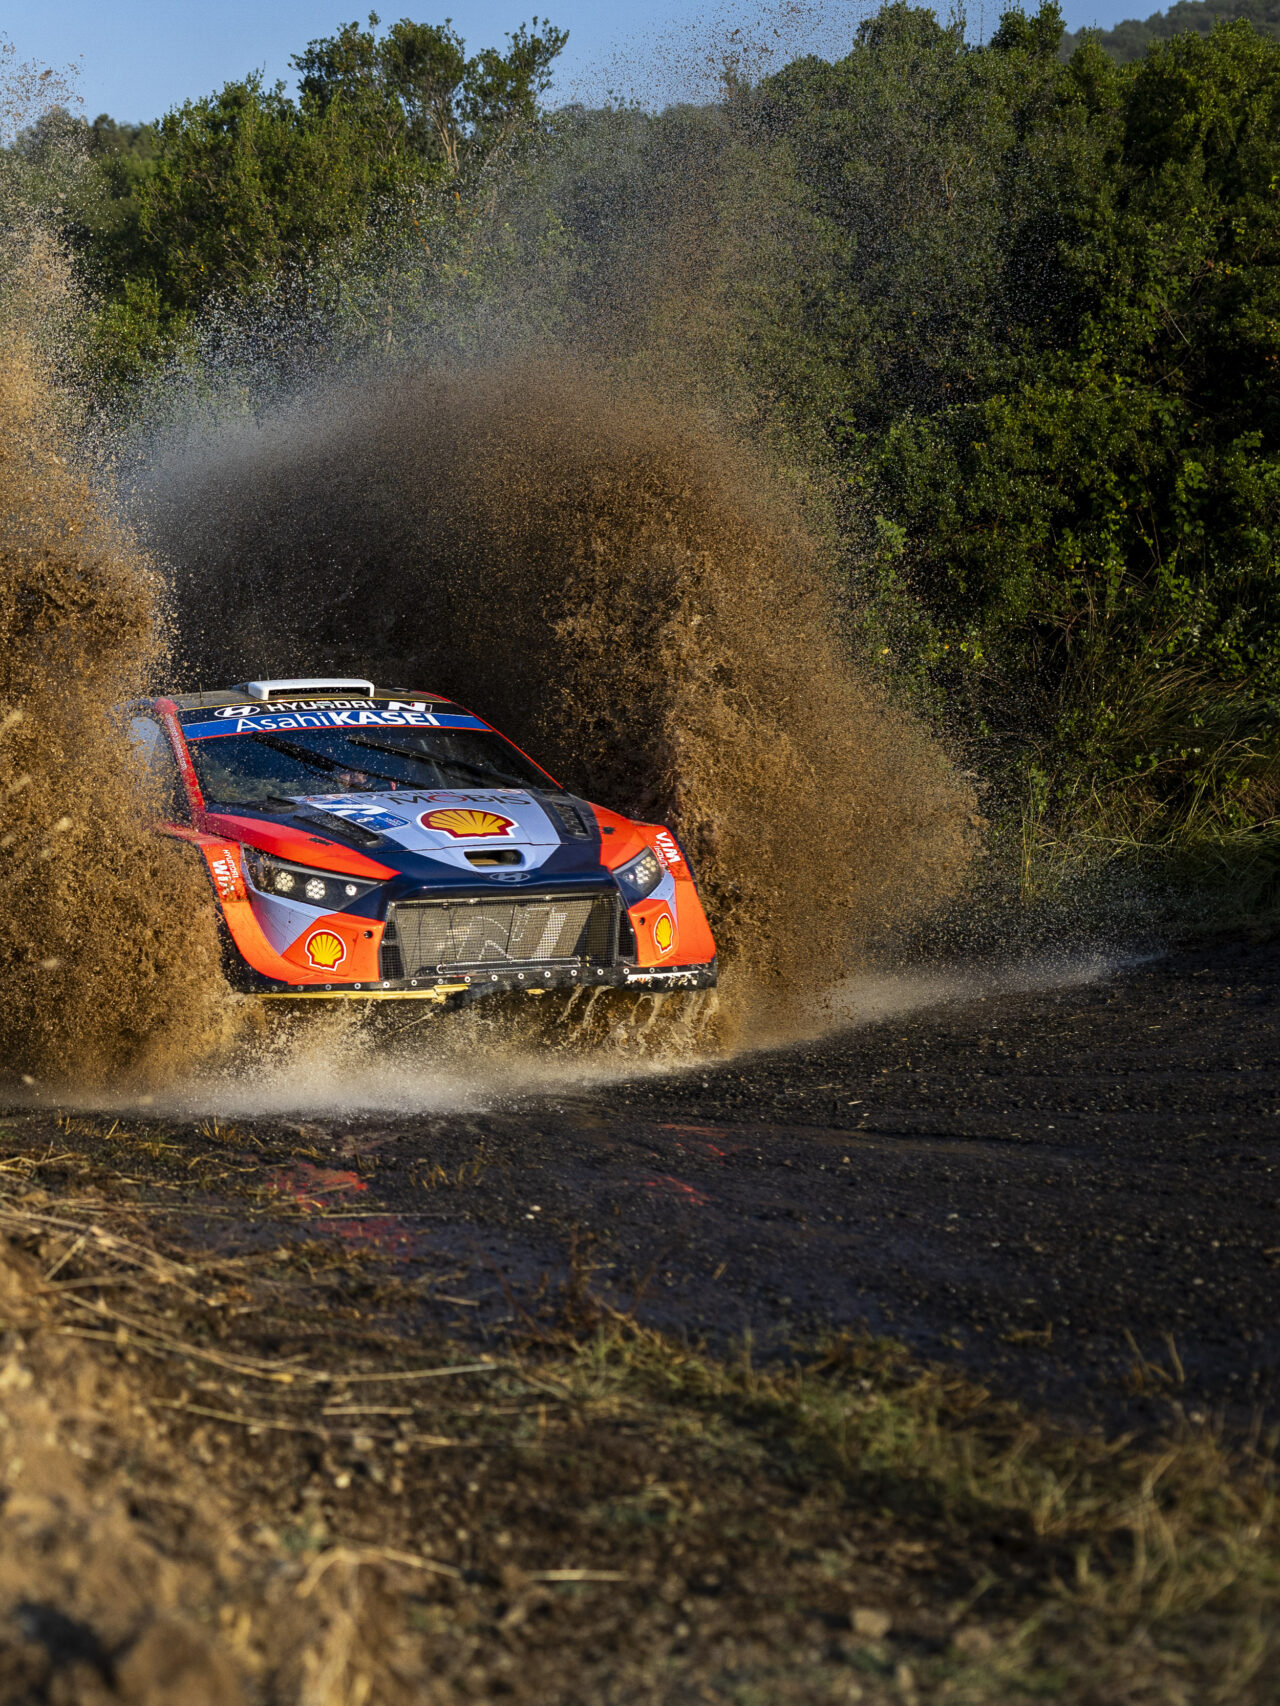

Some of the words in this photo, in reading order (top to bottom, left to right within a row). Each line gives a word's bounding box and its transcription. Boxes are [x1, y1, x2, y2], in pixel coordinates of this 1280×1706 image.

[266, 700, 377, 712] HYUNDAI
[388, 794, 531, 805] MOBIS
[222, 849, 239, 878] HYUNDAI
